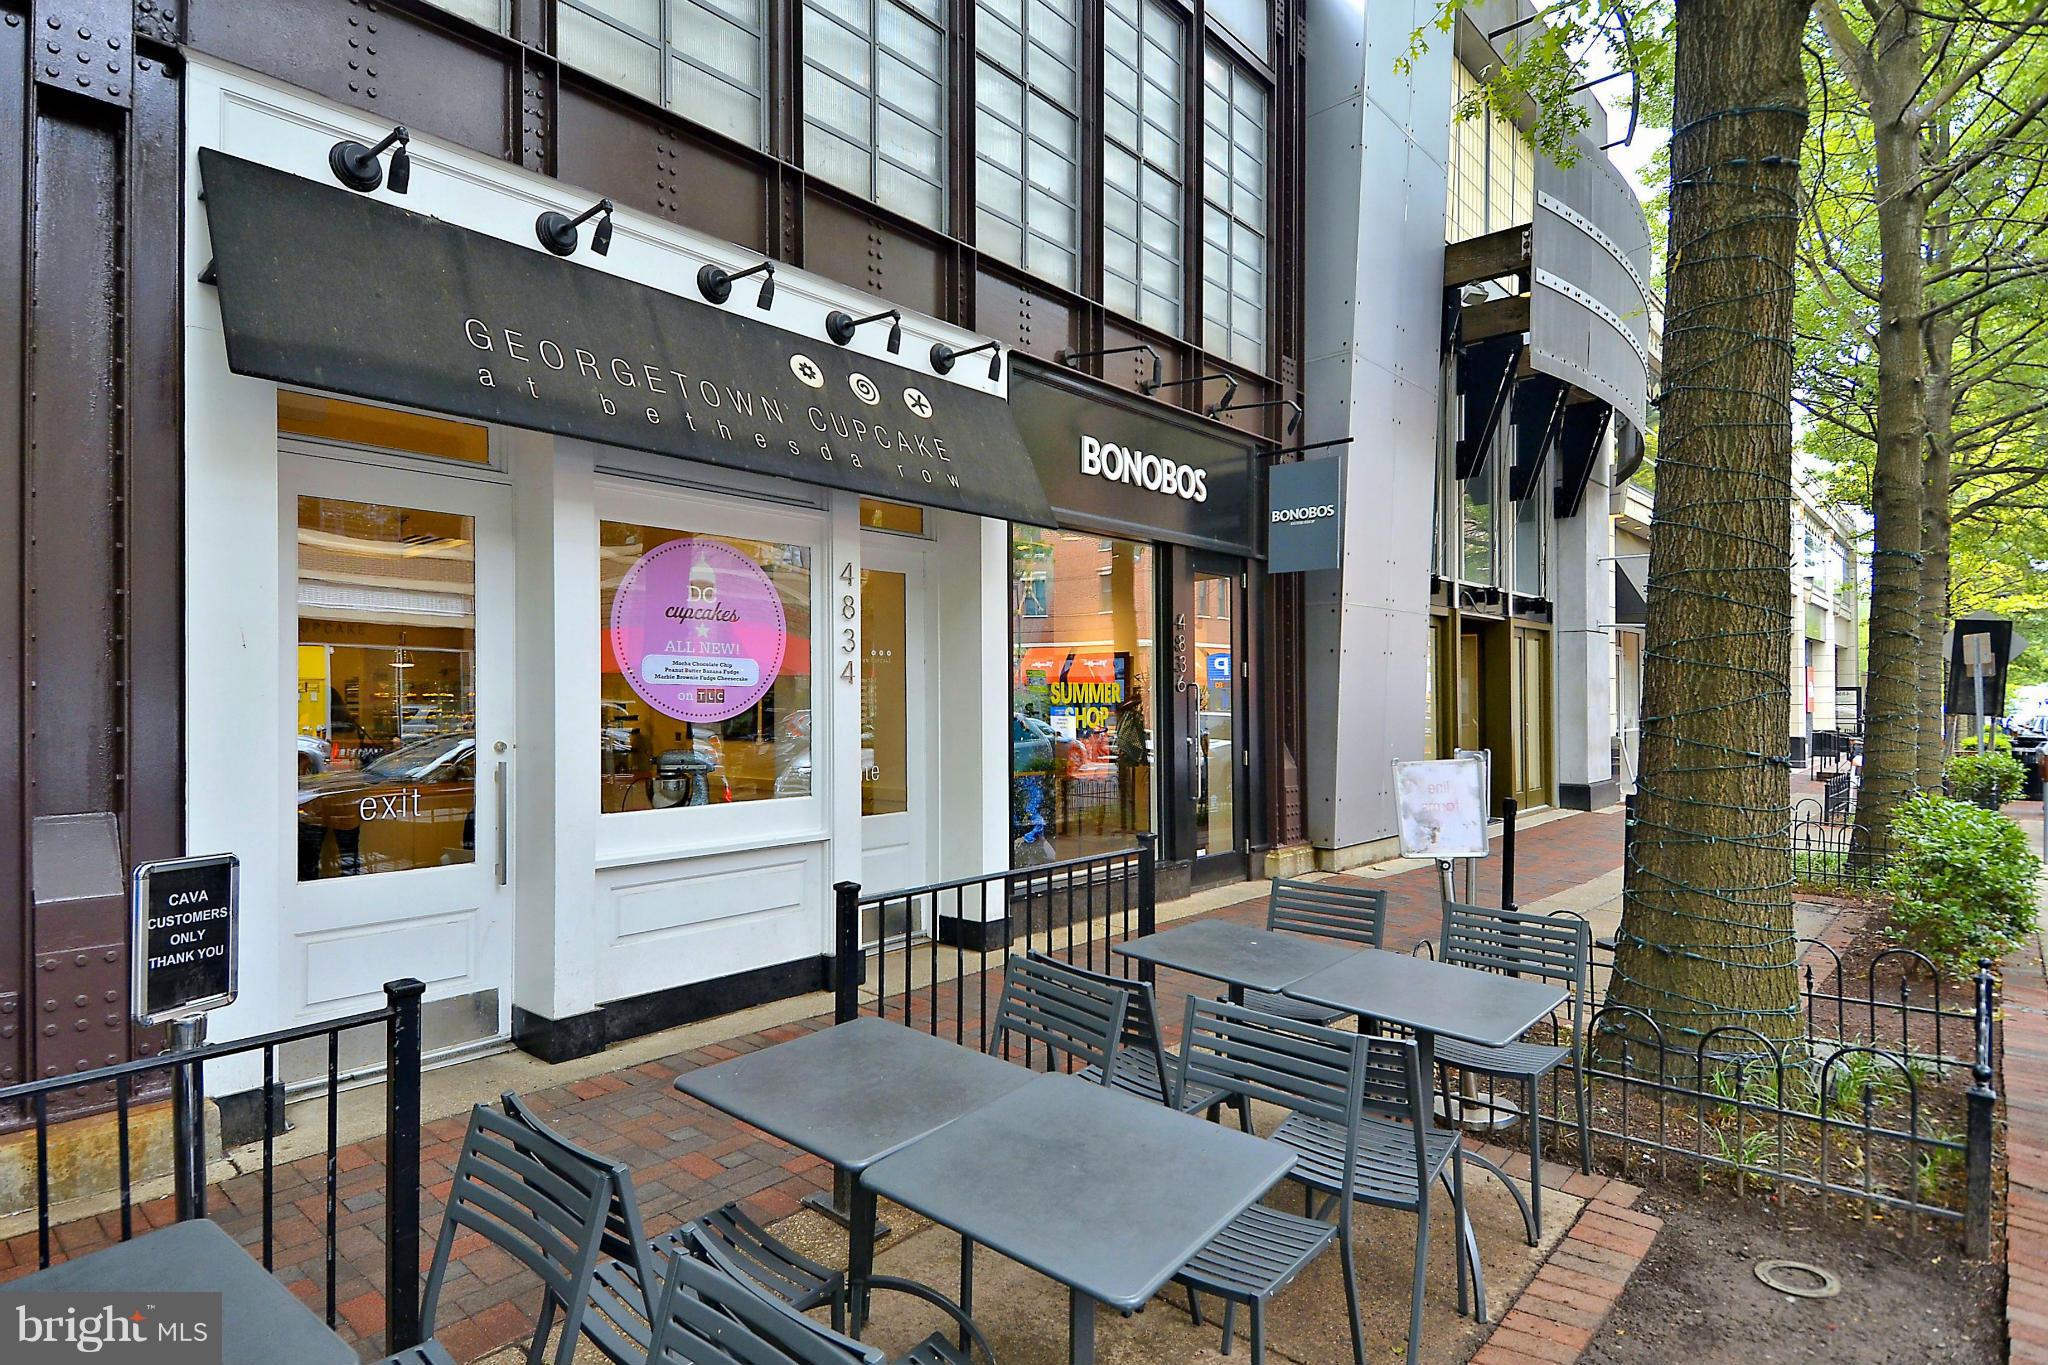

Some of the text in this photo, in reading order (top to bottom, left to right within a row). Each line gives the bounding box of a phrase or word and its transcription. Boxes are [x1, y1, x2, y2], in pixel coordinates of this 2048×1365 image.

[464, 318, 951, 462] GEORGETOWN CUPCAKE
[478, 367, 961, 489] at bethesda row
[1080, 434, 1208, 503] BONOBOS
[1271, 504, 1335, 523] BONOBOS
[686, 585, 718, 604] DC
[665, 602, 741, 625] cupcakes
[839, 561, 856, 686] 4834
[664, 639, 741, 656] ALL NEW!
[1176, 613, 1187, 693] 4836
[719, 661, 733, 669] Chip
[677, 690, 725, 703] on TLC
[1050, 681, 1122, 705] SUMMER
[359, 787, 422, 821] exit
[168, 889, 209, 906] CAVA
[148, 906, 229, 930] CUSTOMERS
[170, 929, 206, 946] ONLY
[148, 944, 225, 969] THANK YOU
